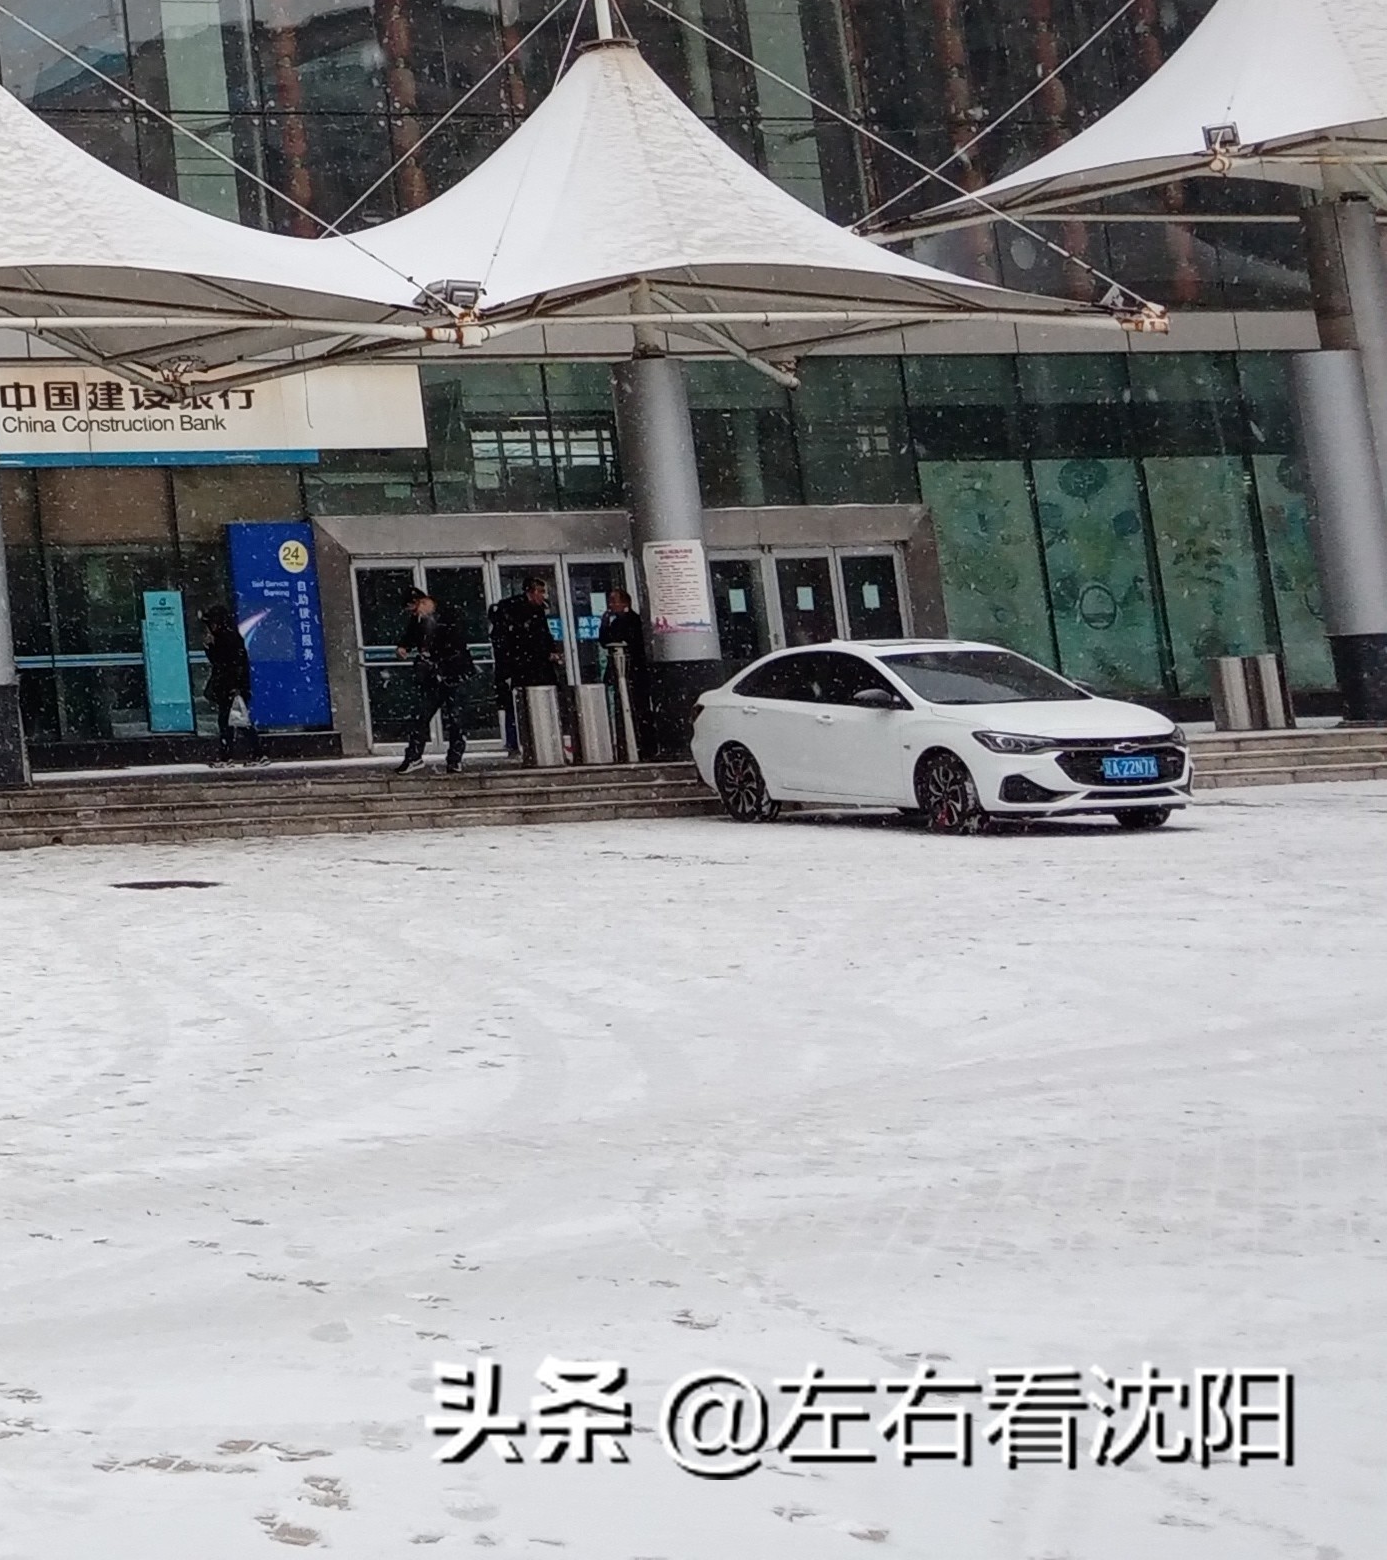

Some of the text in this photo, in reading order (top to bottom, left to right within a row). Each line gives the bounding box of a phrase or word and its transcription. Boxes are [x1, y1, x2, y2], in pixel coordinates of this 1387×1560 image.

[1, 414, 228, 433] China Construction Bank
[282, 546, 300, 562] 24
